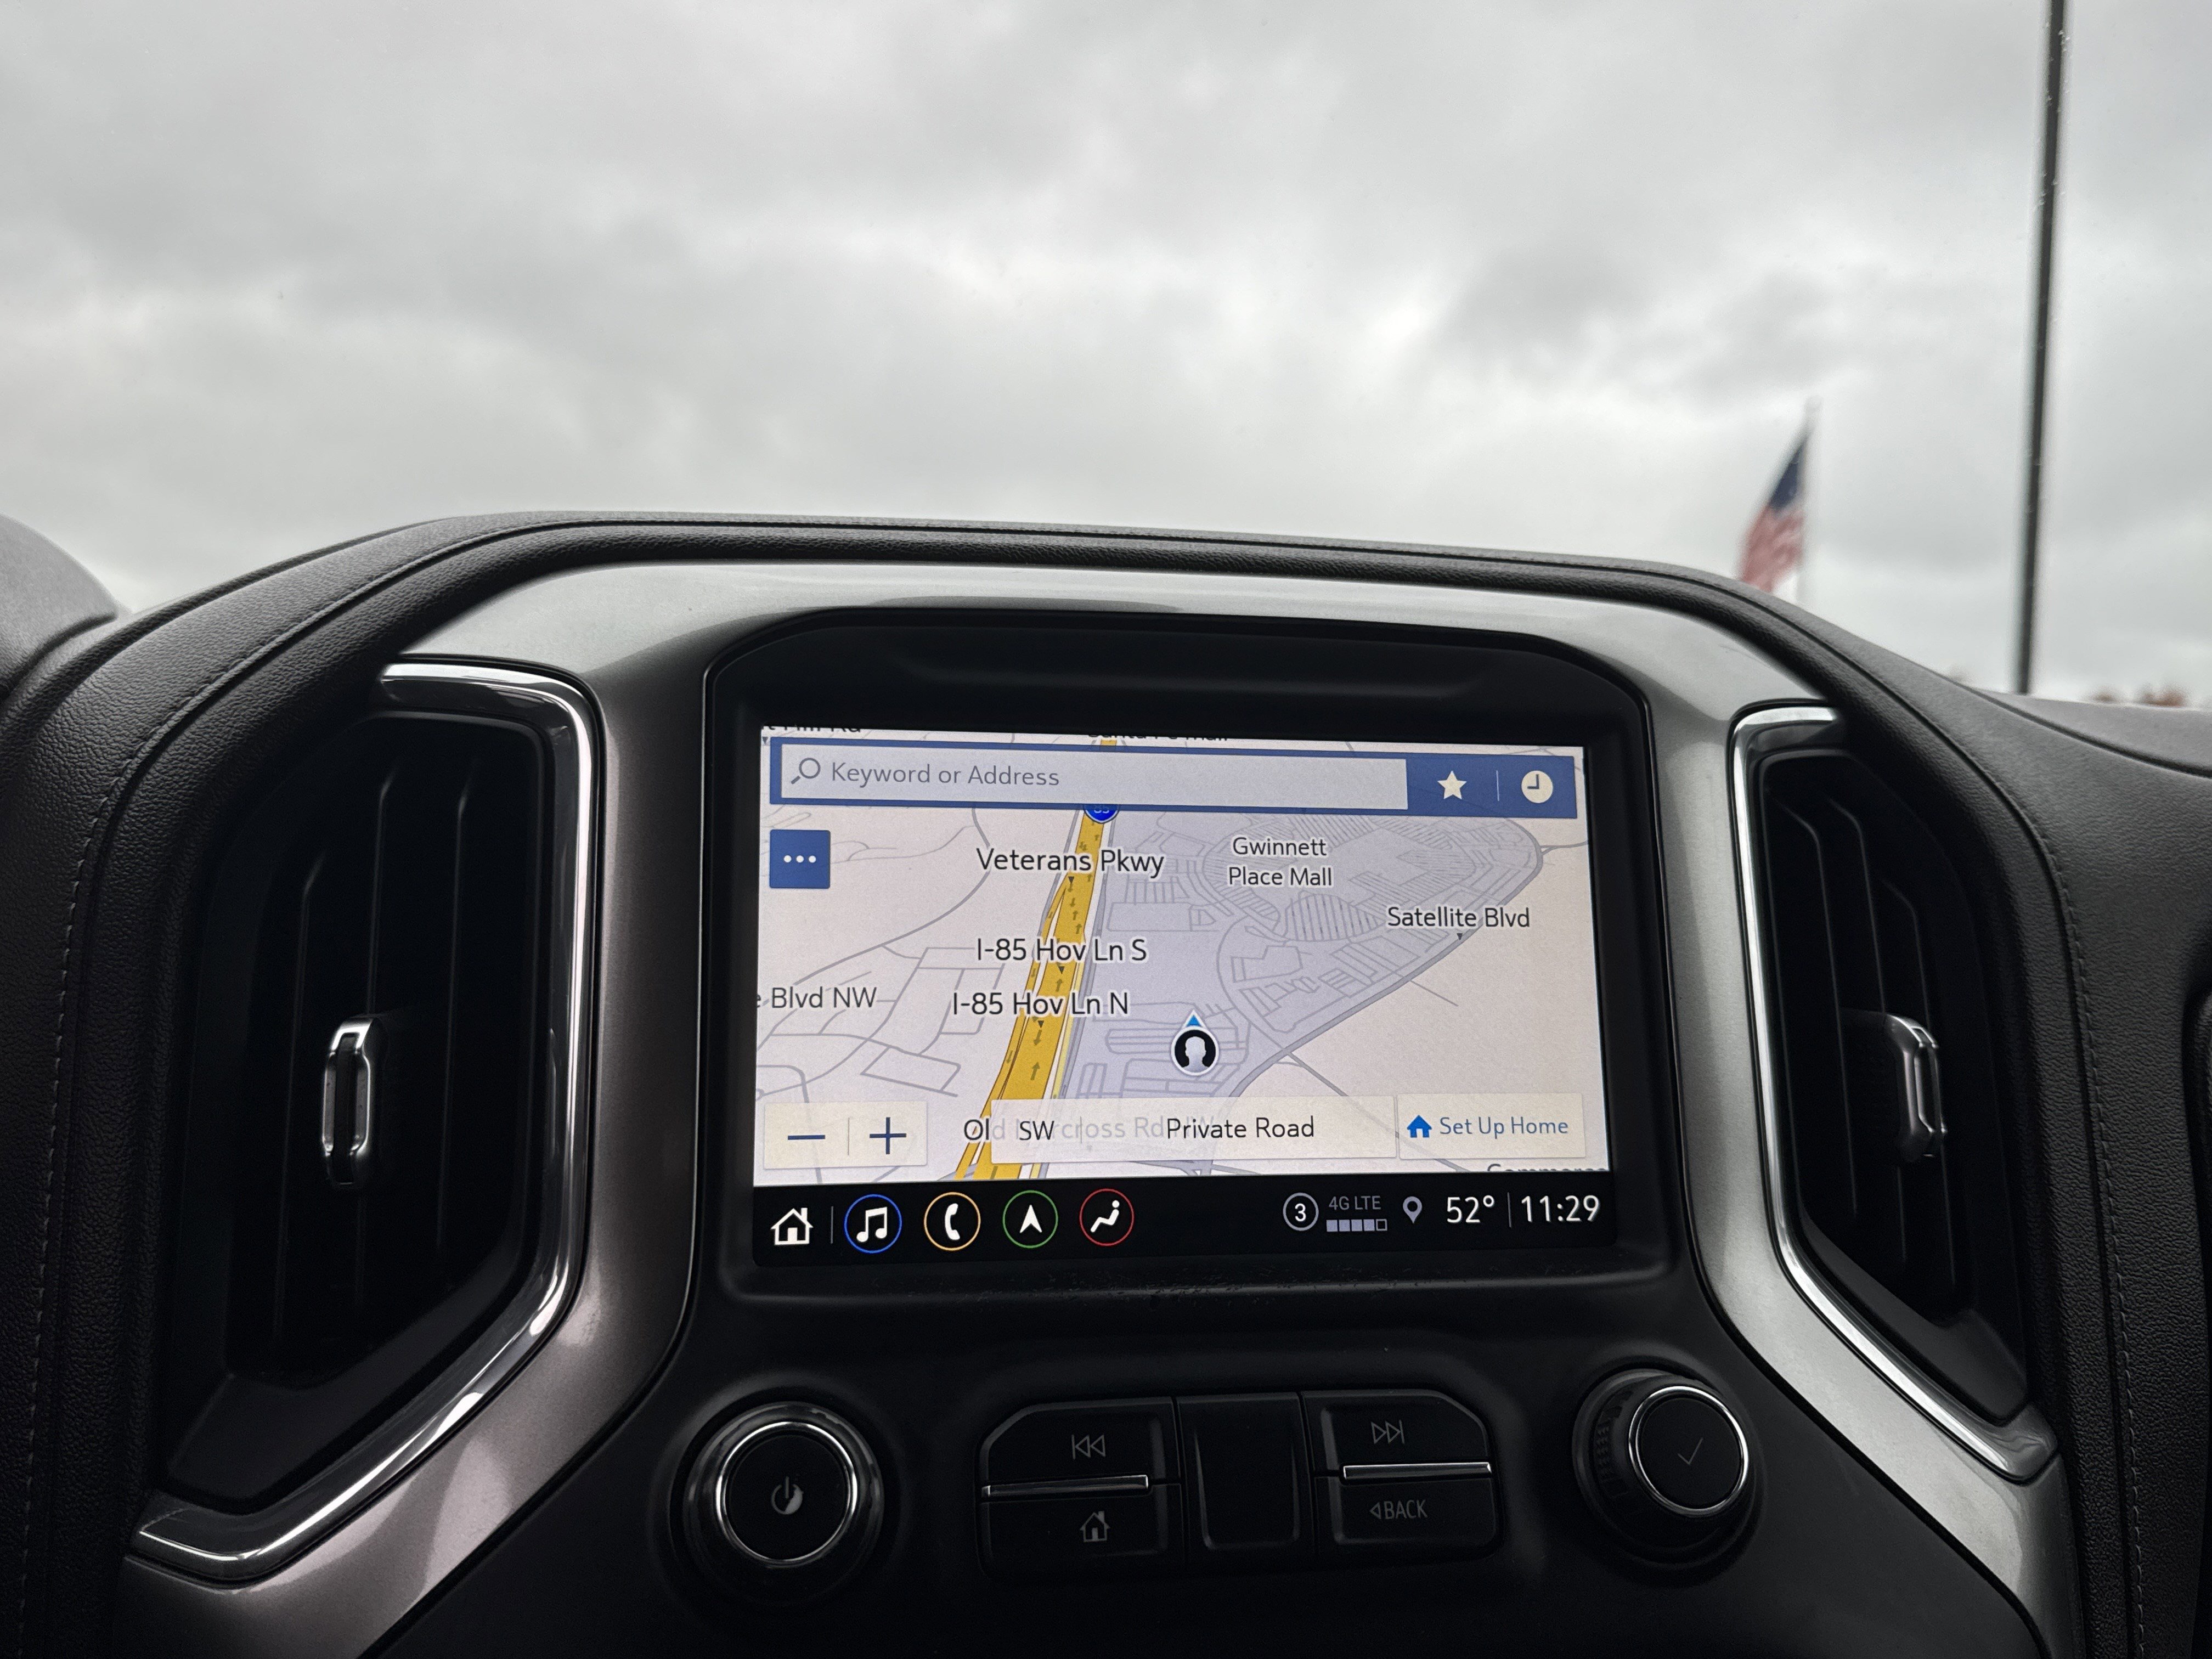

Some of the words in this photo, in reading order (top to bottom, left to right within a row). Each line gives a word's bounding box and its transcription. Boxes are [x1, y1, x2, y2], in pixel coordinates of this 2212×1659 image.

[831, 761, 931, 788] Keyword
[938, 769, 961, 783] or
[967, 766, 1060, 786] Address
[1232, 837, 1327, 856] Gwinnett
[976, 848, 1092, 871] Veterans
[1101, 849, 1165, 878] Pkwy
[1228, 867, 1283, 885] Place
[1290, 868, 1332, 886] Mall
[1387, 906, 1477, 928] Satellite
[1484, 908, 1531, 928] Blvd
[977, 939, 1026, 961] I-85
[1037, 939, 1086, 961] Hov
[1094, 940, 1125, 961] Ln
[1131, 940, 1147, 961] S
[772, 986, 823, 1008] Blvd
[833, 987, 877, 1008] NW
[952, 992, 1003, 1014] I-85
[1013, 993, 1063, 1014] Hov
[1071, 993, 1104, 1015] Ln
[1111, 993, 1128, 1014] N
[1019, 1120, 1054, 1141] SW
[1167, 1117, 1247, 1140] Private
[1256, 1116, 1314, 1138] Road
[1439, 1118, 1472, 1135] Set
[1478, 1117, 1505, 1139] Up
[1511, 1116, 1568, 1135] Home
[1294, 1203, 1307, 1222] 3
[1328, 1197, 1350, 1210] 4G
[1354, 1195, 1381, 1210] LTE
[1521, 1195, 1600, 1223] 11:29
[1384, 1499, 1428, 1520] BACK
